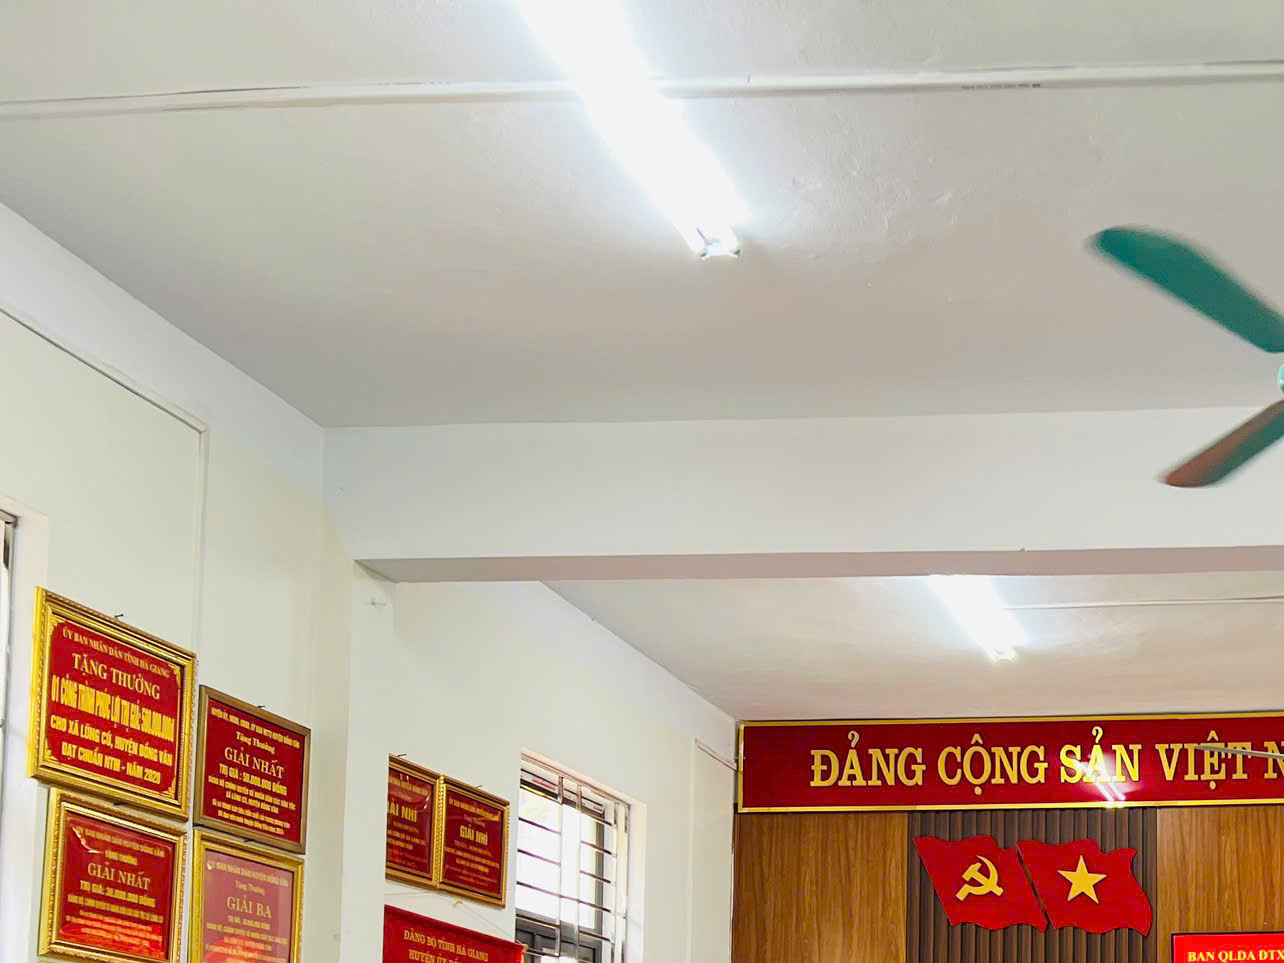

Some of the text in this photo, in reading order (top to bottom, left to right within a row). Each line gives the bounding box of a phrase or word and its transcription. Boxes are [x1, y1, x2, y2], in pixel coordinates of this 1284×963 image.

[72, 653, 160, 700] TẶNG THƯỞNG
[50, 714, 67, 732] CHO
[68, 719, 79, 736] XÃ
[224, 746, 284, 779] GIẢI NHẤT
[810, 731, 926, 787] ĐẢNG
[937, 733, 1048, 796] CỘNG
[1059, 726, 1140, 784] SẢN
[1155, 730, 1252, 790] VIỆT
[87, 861, 151, 891] GIẢI NHẤT
[226, 894, 272, 919] GIẢI BA
[1187, 951, 1215, 962] BAN
[1218, 951, 1256, 963] QLDA
